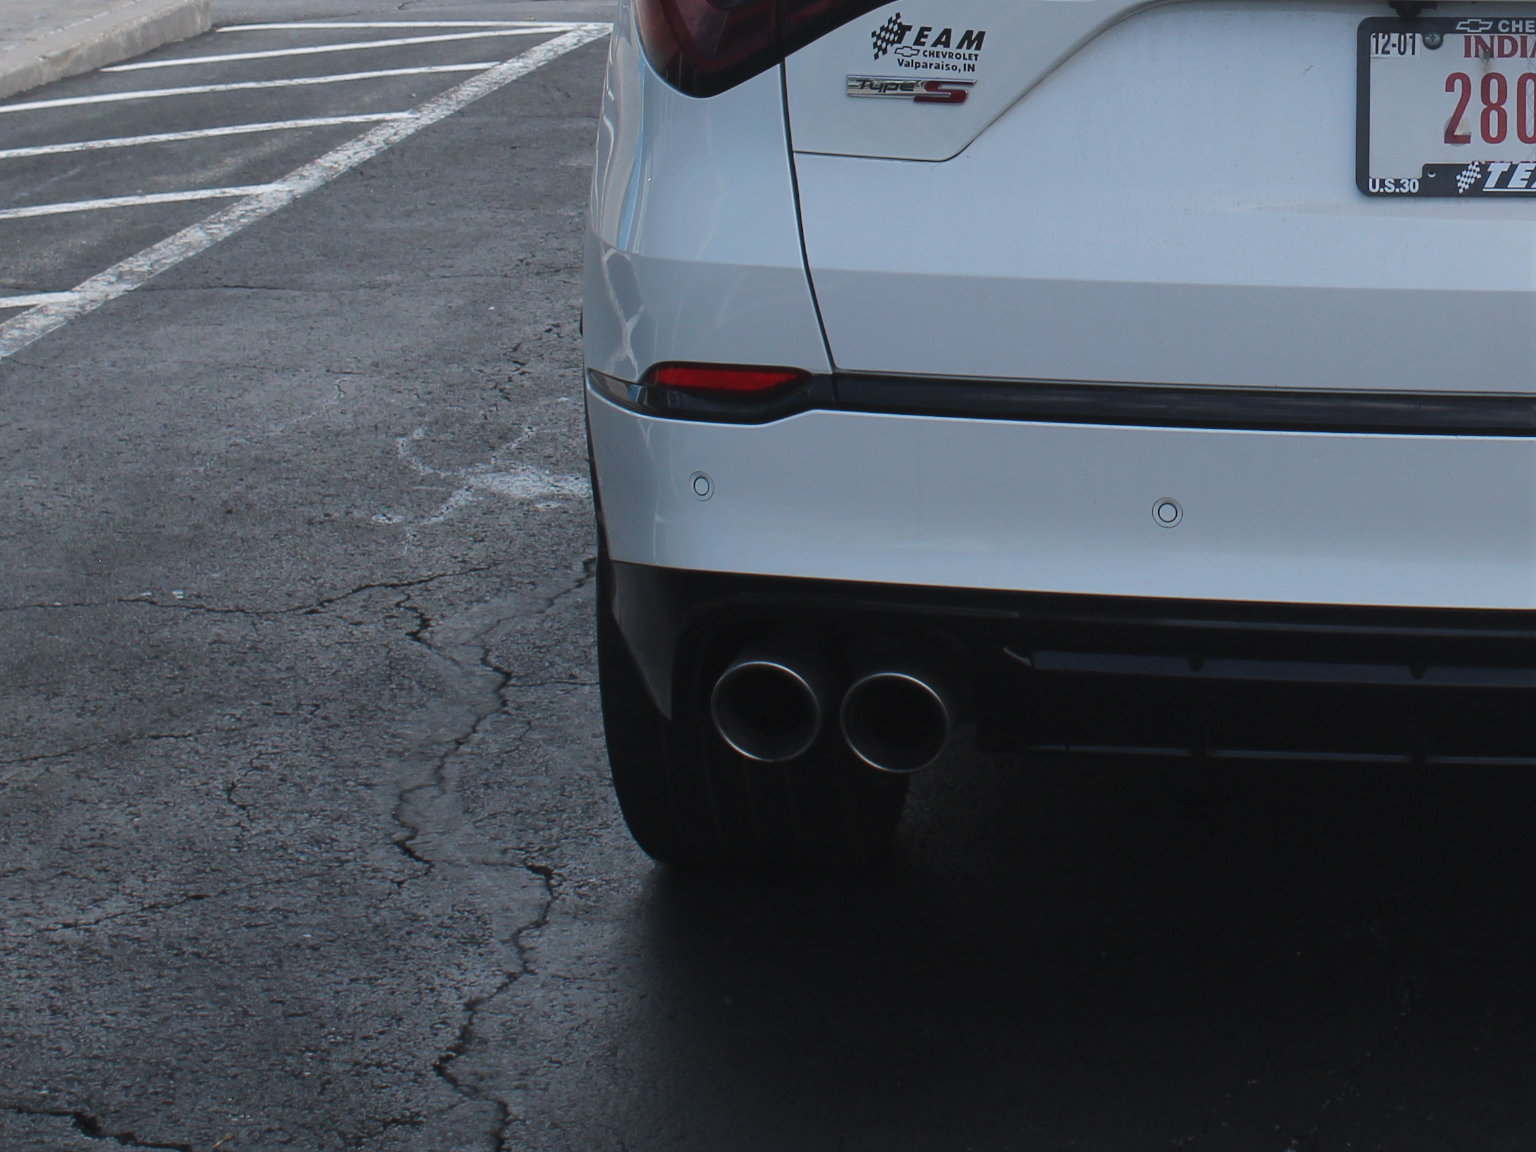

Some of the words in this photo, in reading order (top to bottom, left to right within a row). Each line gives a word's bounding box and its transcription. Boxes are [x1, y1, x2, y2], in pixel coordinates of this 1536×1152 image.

[898, 24, 987, 51] TEAM
[1372, 33, 1417, 56] 12-01
[897, 58, 962, 73] Valparaiso,
[963, 63, 976, 73] IN
[922, 49, 980, 62] CHEVROLET
[856, 79, 917, 93] Type
[914, 79, 978, 104] S
[1368, 177, 1420, 194] U.S.30
